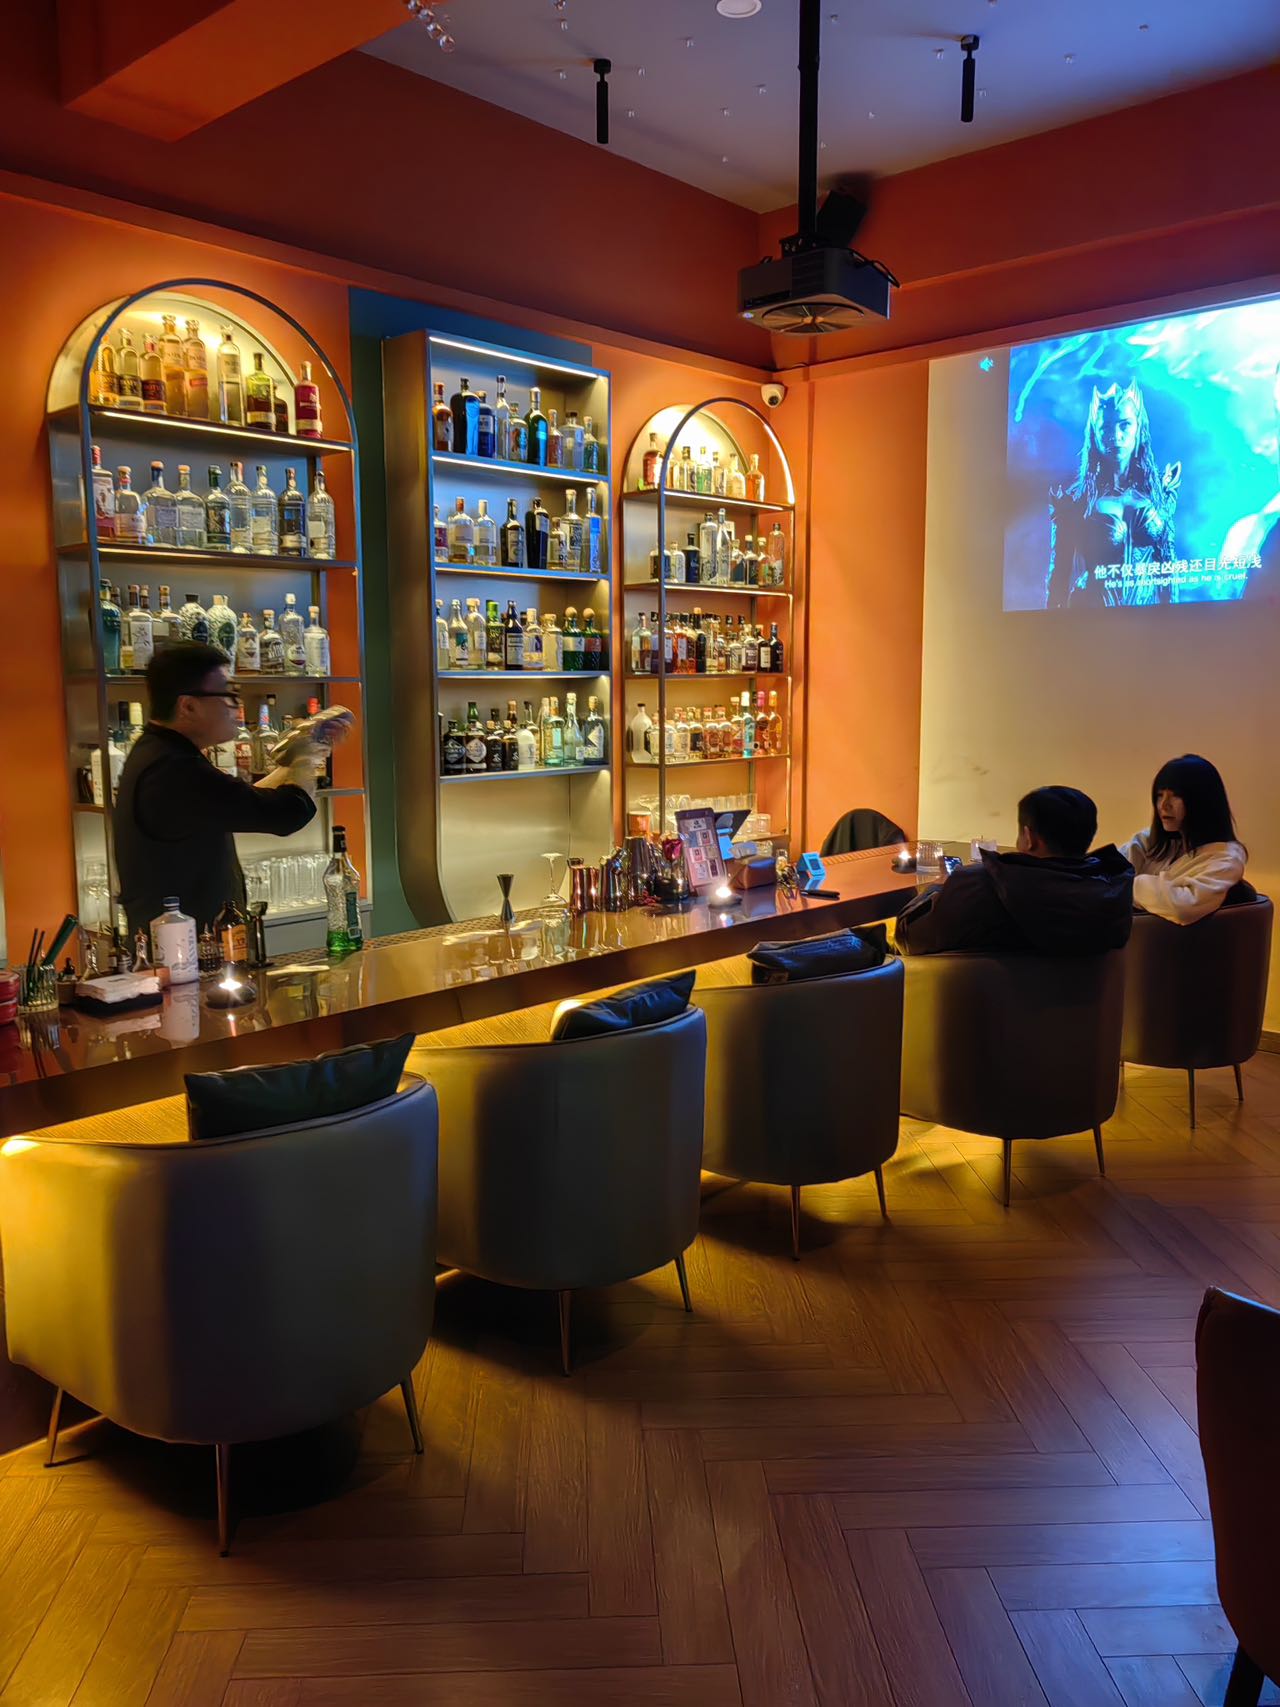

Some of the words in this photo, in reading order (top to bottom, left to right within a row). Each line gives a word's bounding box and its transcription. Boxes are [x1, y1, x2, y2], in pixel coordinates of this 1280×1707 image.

[1094, 553, 1262, 580] 他不仅暴戾凶残还目光短浅
[1104, 579, 1123, 589] He's
[1201, 574, 1212, 582] he
